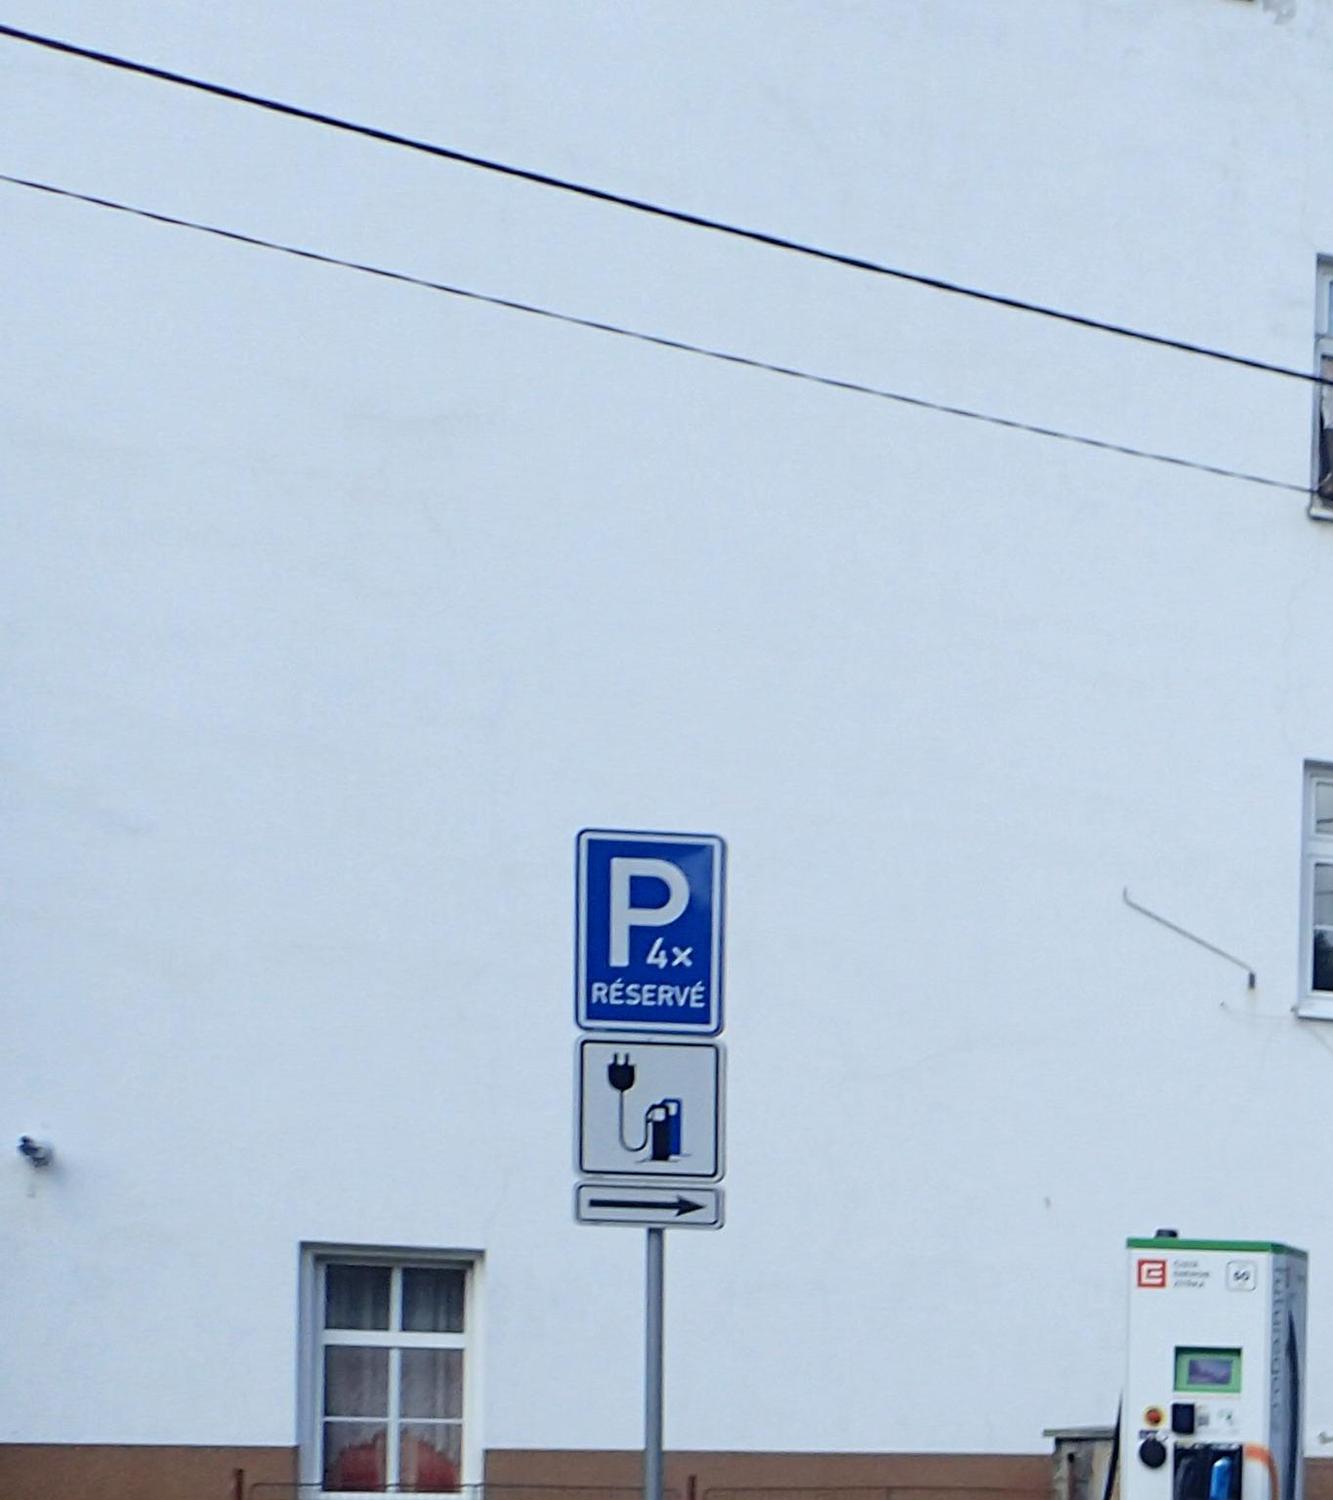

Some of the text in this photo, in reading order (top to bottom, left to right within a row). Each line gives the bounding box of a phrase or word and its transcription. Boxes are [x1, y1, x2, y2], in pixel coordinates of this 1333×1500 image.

[610, 857, 690, 967] P
[646, 937, 693, 970] 4x
[592, 978, 706, 1008] RÉSERVÉ
